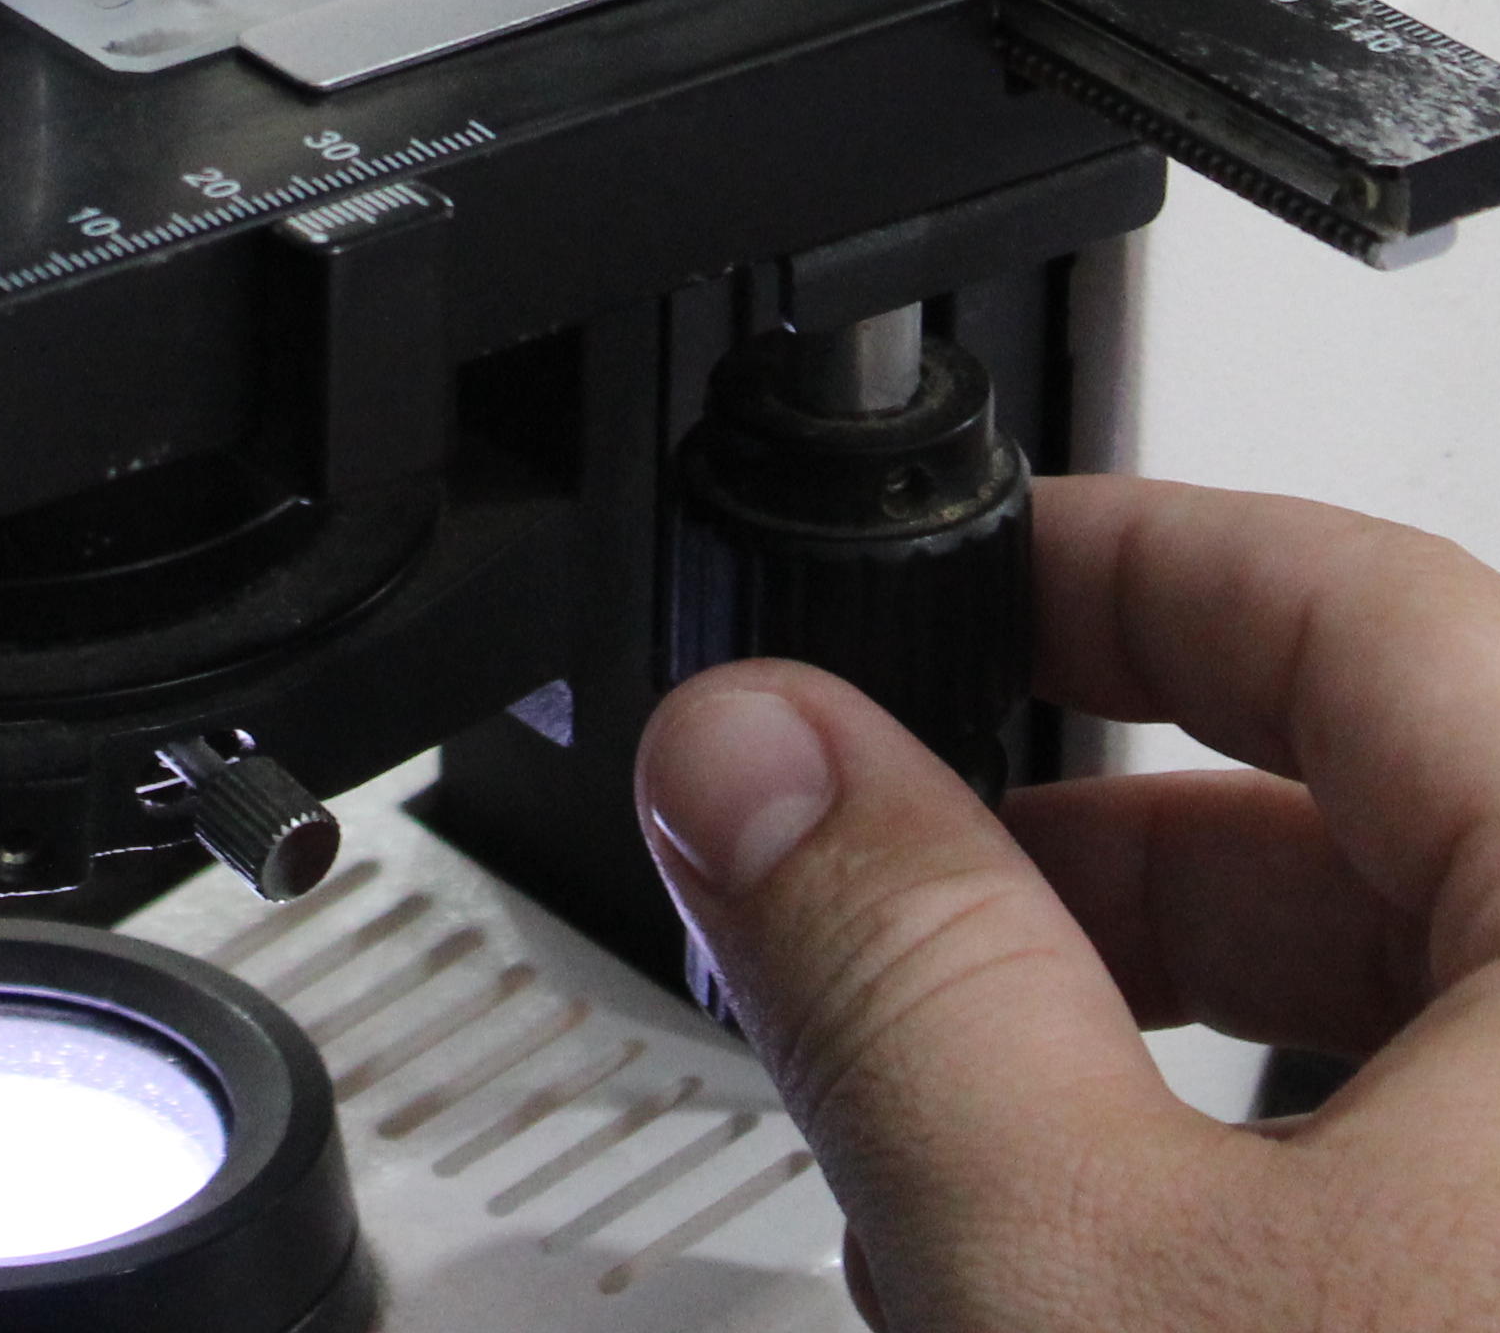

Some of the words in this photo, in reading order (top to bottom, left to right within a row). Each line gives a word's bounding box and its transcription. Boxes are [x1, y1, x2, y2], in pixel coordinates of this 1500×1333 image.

[1332, 17, 1402, 53] 140
[67, 206, 121, 237] 10
[180, 166, 242, 200] 20
[303, 130, 361, 162] 30
